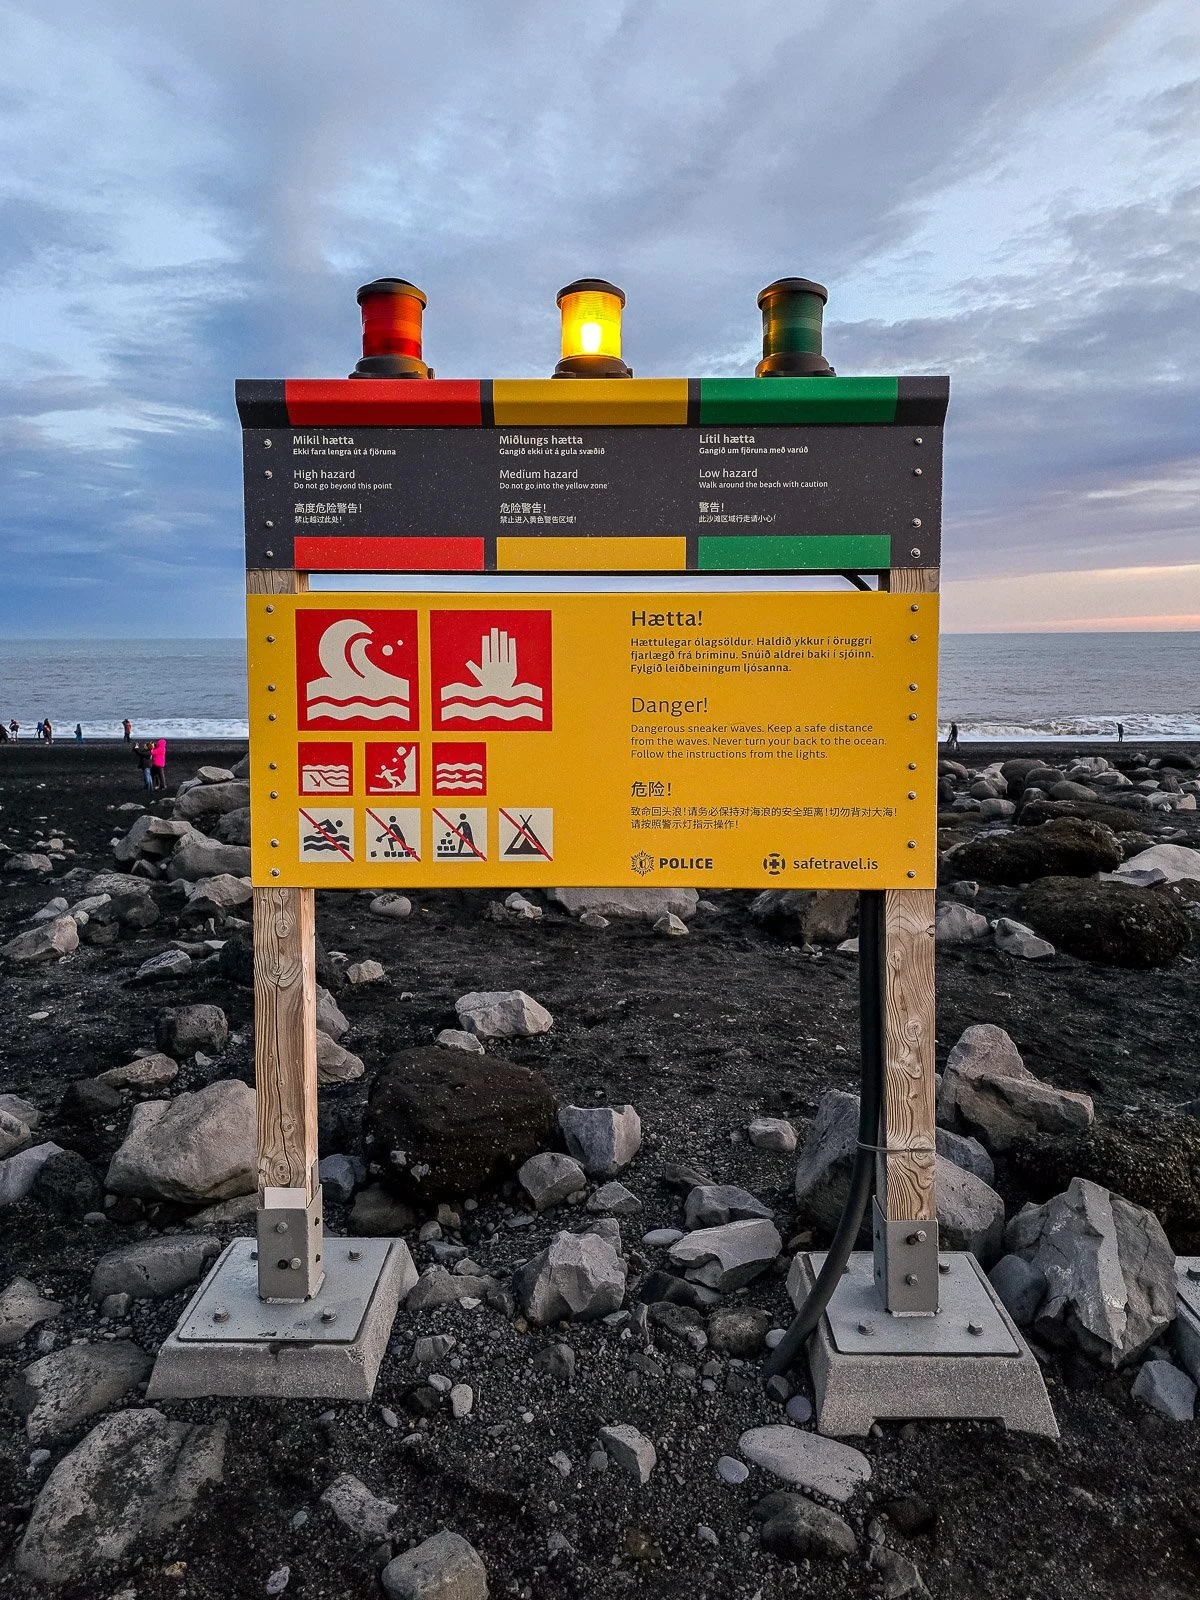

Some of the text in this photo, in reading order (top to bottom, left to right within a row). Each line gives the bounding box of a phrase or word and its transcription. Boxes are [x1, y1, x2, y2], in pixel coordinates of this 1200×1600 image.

[292, 435, 354, 445] Mikil hætta
[499, 435, 583, 447] Miðlungs hætta
[699, 434, 755, 444] Lítil hætta
[327, 448, 352, 457] lengra
[369, 448, 396, 457] fjöruna
[499, 448, 526, 457] Gangið
[560, 448, 577, 457] gula
[699, 447, 726, 456] Gangið
[740, 447, 768, 456] fjöruna
[294, 469, 355, 480] High hazard
[499, 469, 578, 479] Medium hazard
[699, 468, 758, 478] Low hazard
[330, 482, 356, 491] beyond
[373, 482, 392, 491] point
[565, 482, 589, 491] yellow
[631, 610, 703, 626] Hætta!
[630, 637, 692, 649] Hættulegar
[694, 637, 754, 649] ólagsöldur.
[756, 636, 792, 646] Haldið
[794, 637, 825, 649] ykkur
[832, 636, 872, 648] öruggri
[630, 650, 675, 662] fjarlægð
[677, 650, 692, 659] frá
[695, 650, 738, 659] briminu.
[741, 649, 771, 659] Snúið
[774, 649, 804, 659] aldrei
[807, 649, 830, 659] baki
[838, 649, 874, 661] sjóinn.
[630, 663, 792, 675] Fylgið leiðbeiningum ljósanna.
[631, 697, 708, 716] Danger!
[631, 724, 685, 735] Dangerous
[687, 724, 727, 733] sneaker
[767, 724, 793, 734] Keep
[804, 724, 827, 732] safe
[829, 724, 873, 732] distance
[631, 737, 654, 746] from
[657, 737, 674, 746] the
[712, 737, 742, 746] Never
[744, 738, 766, 746] turn
[768, 738, 791, 747] your
[793, 737, 817, 745] back
[820, 737, 831, 745] to
[834, 736, 851, 745] the
[631, 749, 828, 760] Follow the instructions from the lights.
[659, 858, 713, 869] POLICE
[793, 858, 878, 870] safetravel.is
